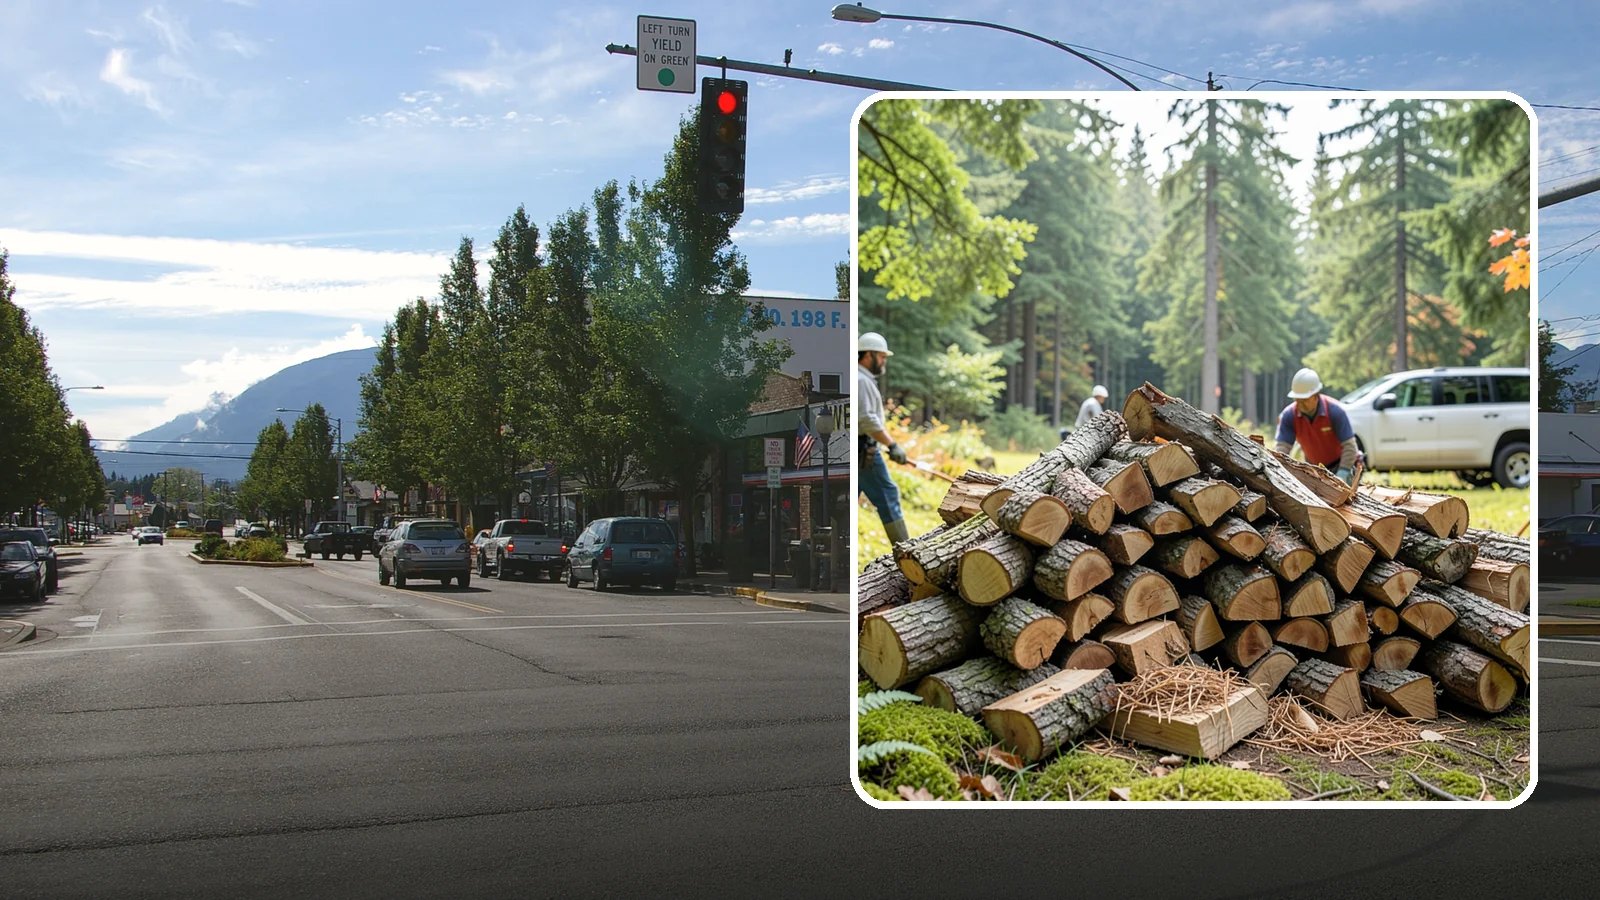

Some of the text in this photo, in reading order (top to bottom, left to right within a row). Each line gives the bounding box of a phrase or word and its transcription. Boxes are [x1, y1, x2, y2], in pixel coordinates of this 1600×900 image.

[643, 23, 690, 37] LEFT TURN
[652, 38, 682, 52] YIELD
[644, 53, 689, 66] ON GREEN
[791, 309, 826, 328] 198
[831, 311, 846, 329] F.
